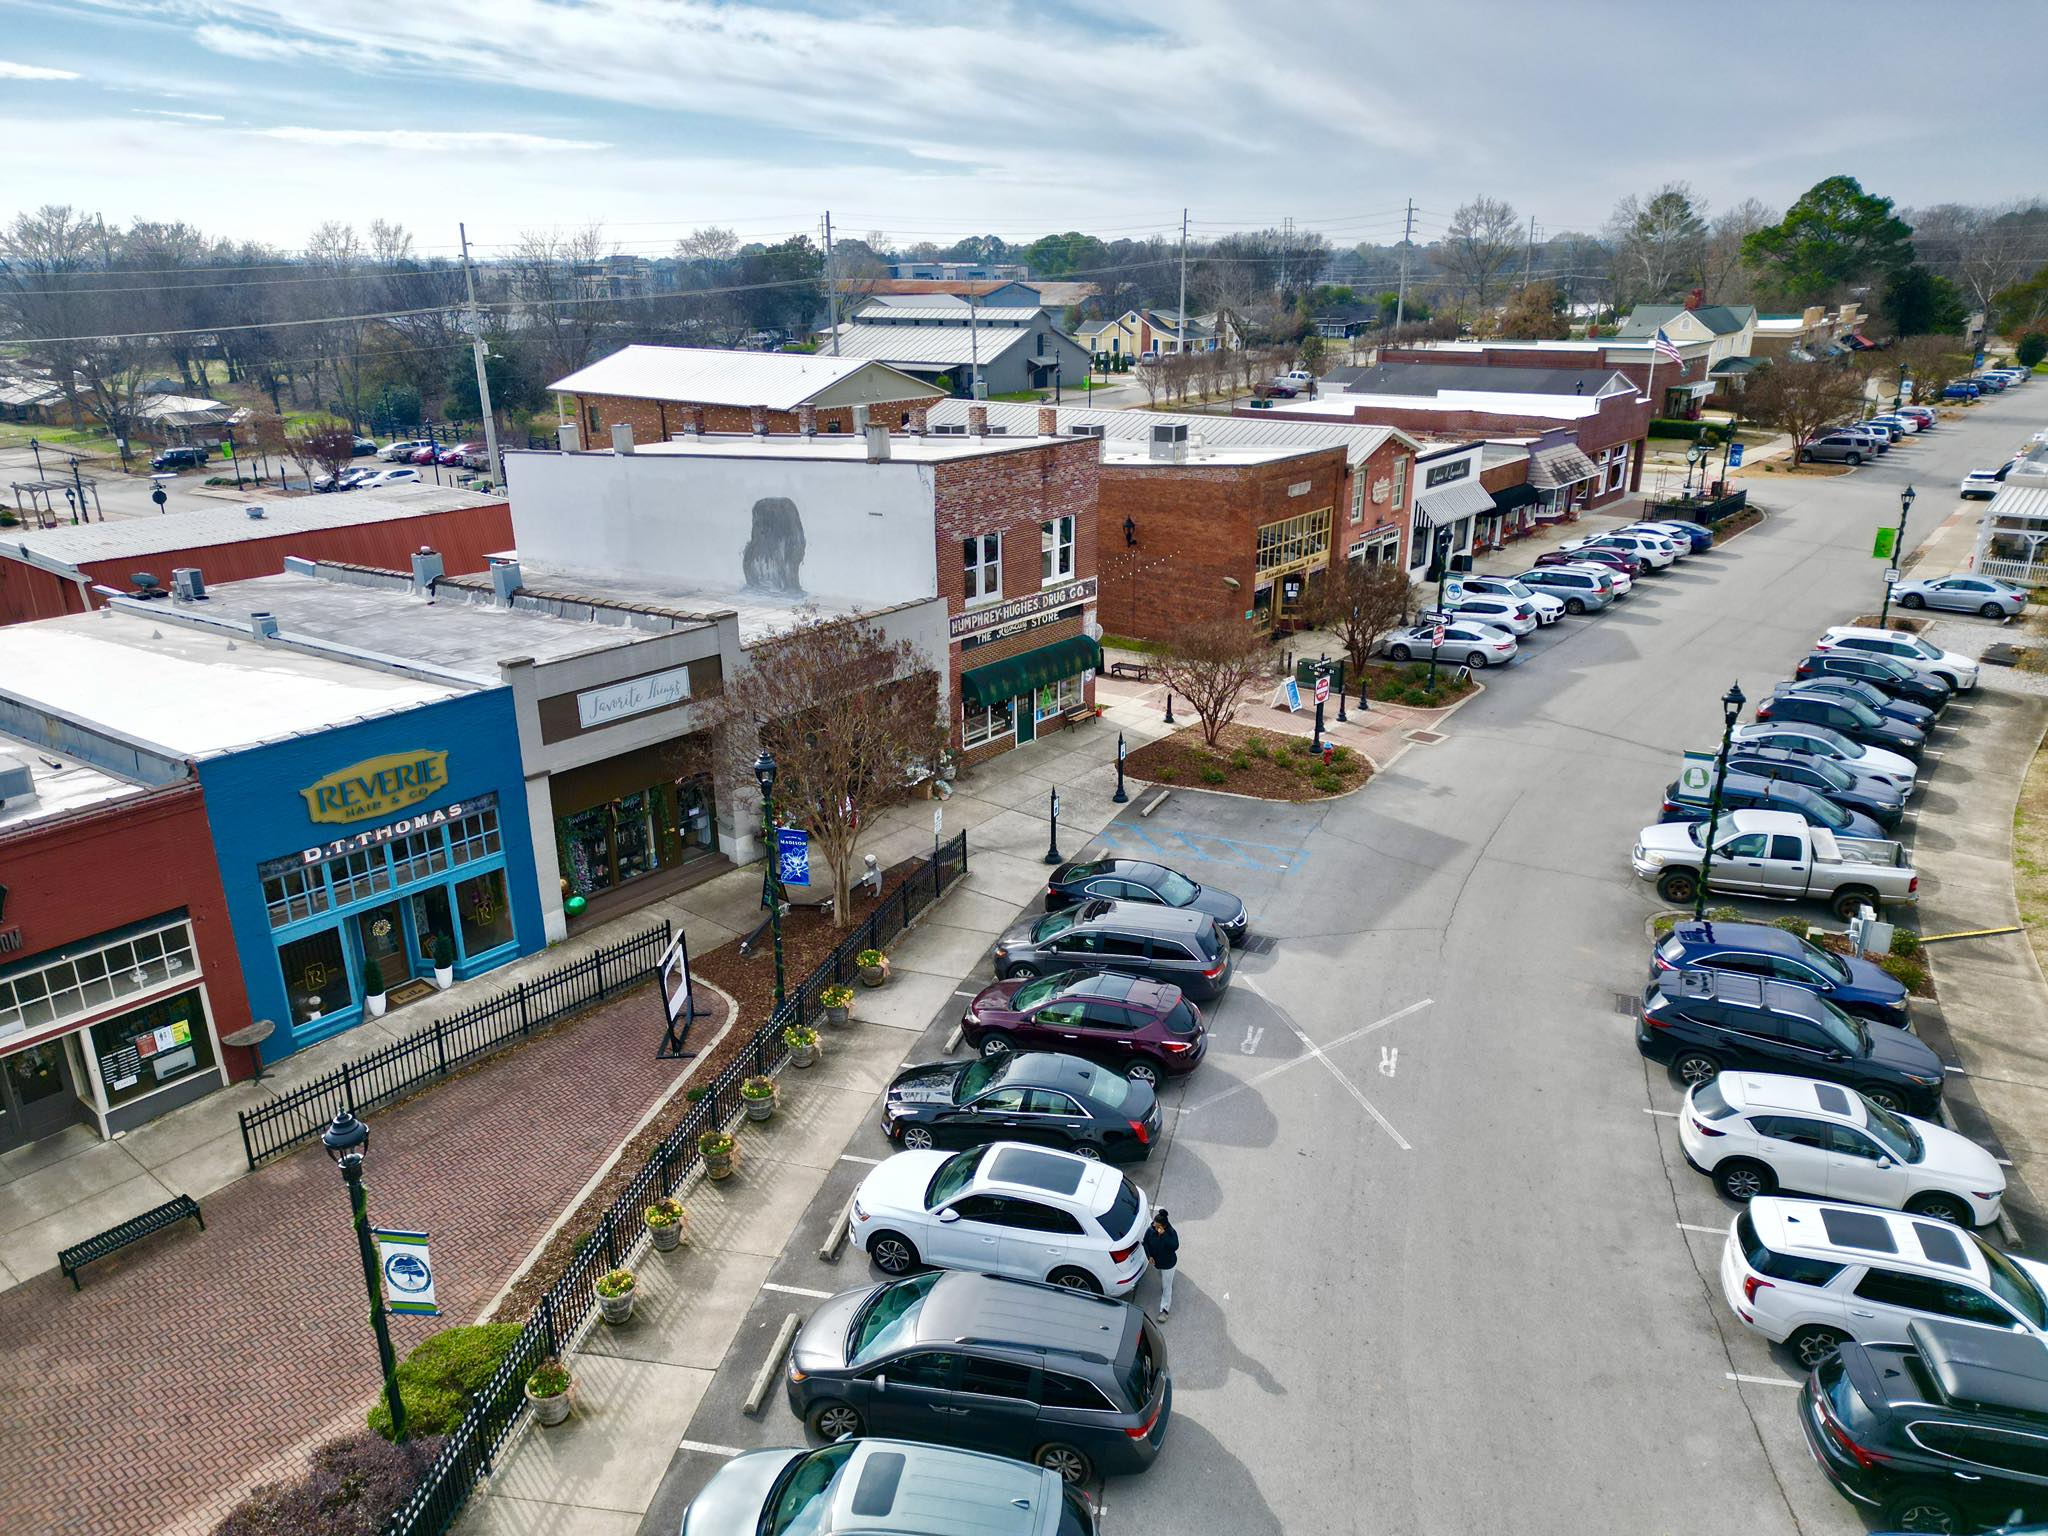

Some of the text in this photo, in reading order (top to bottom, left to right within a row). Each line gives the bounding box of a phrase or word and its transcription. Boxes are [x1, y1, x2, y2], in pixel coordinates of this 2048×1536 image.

[1042, 590, 1066, 607] DRUG
[976, 630, 992, 645] THE
[1032, 611, 1060, 628] STORE
[315, 756, 442, 814] REVERIE
[345, 786, 429, 819] HAIR & CO
[0, 928, 23, 954] OM
